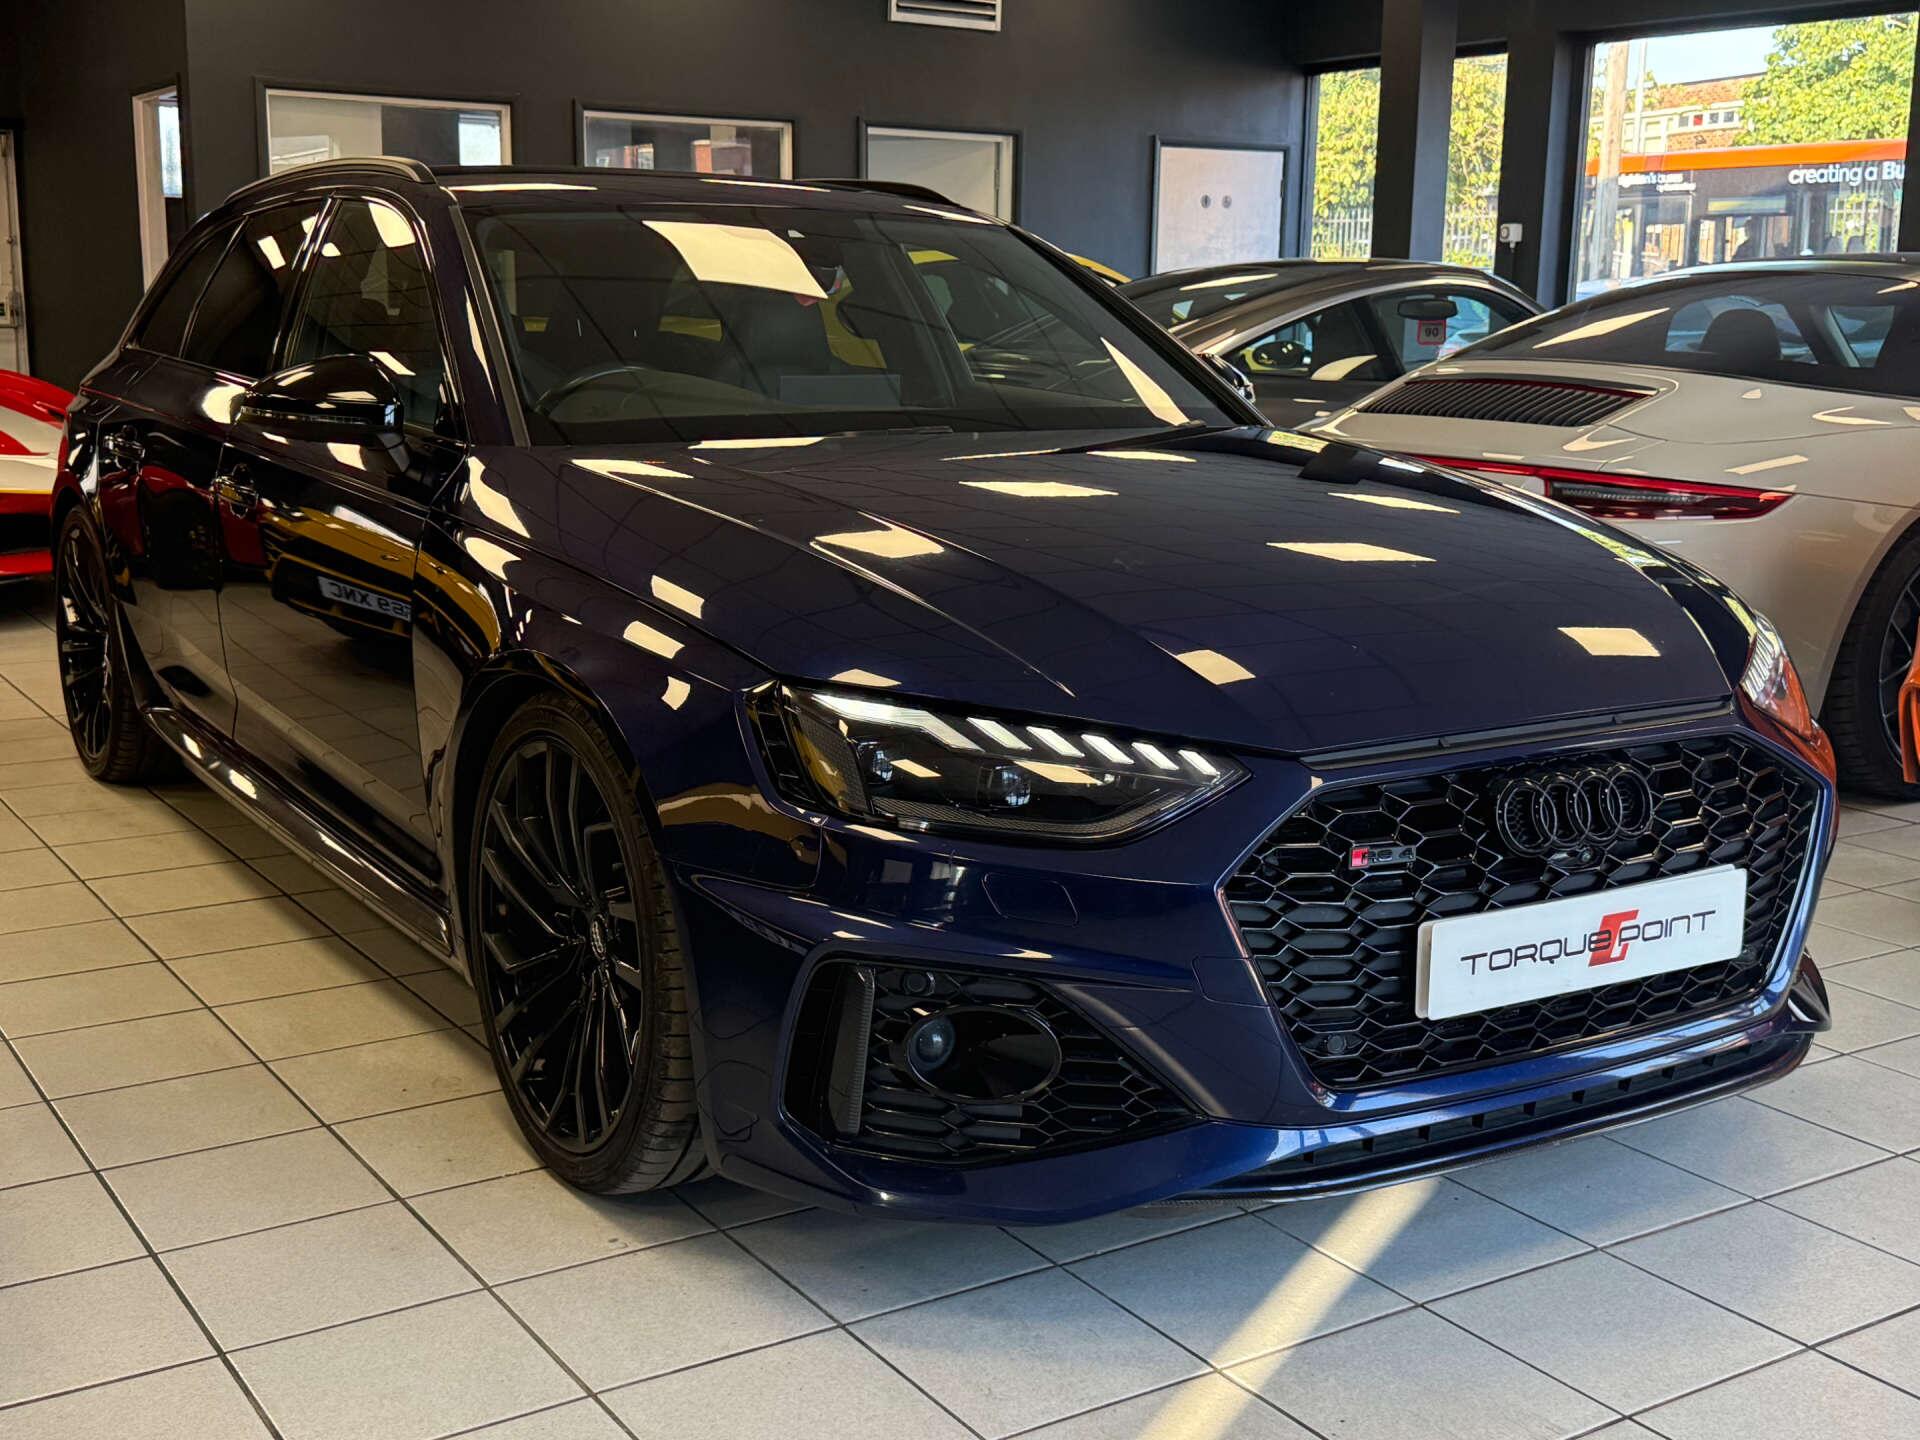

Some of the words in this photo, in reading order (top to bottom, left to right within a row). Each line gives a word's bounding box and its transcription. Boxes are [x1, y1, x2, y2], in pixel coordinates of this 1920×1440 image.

[1788, 164, 1863, 186] creating
[1865, 165, 1878, 181] a
[1460, 929, 1611, 975] TORQUE
[1618, 910, 1716, 947] POINT
